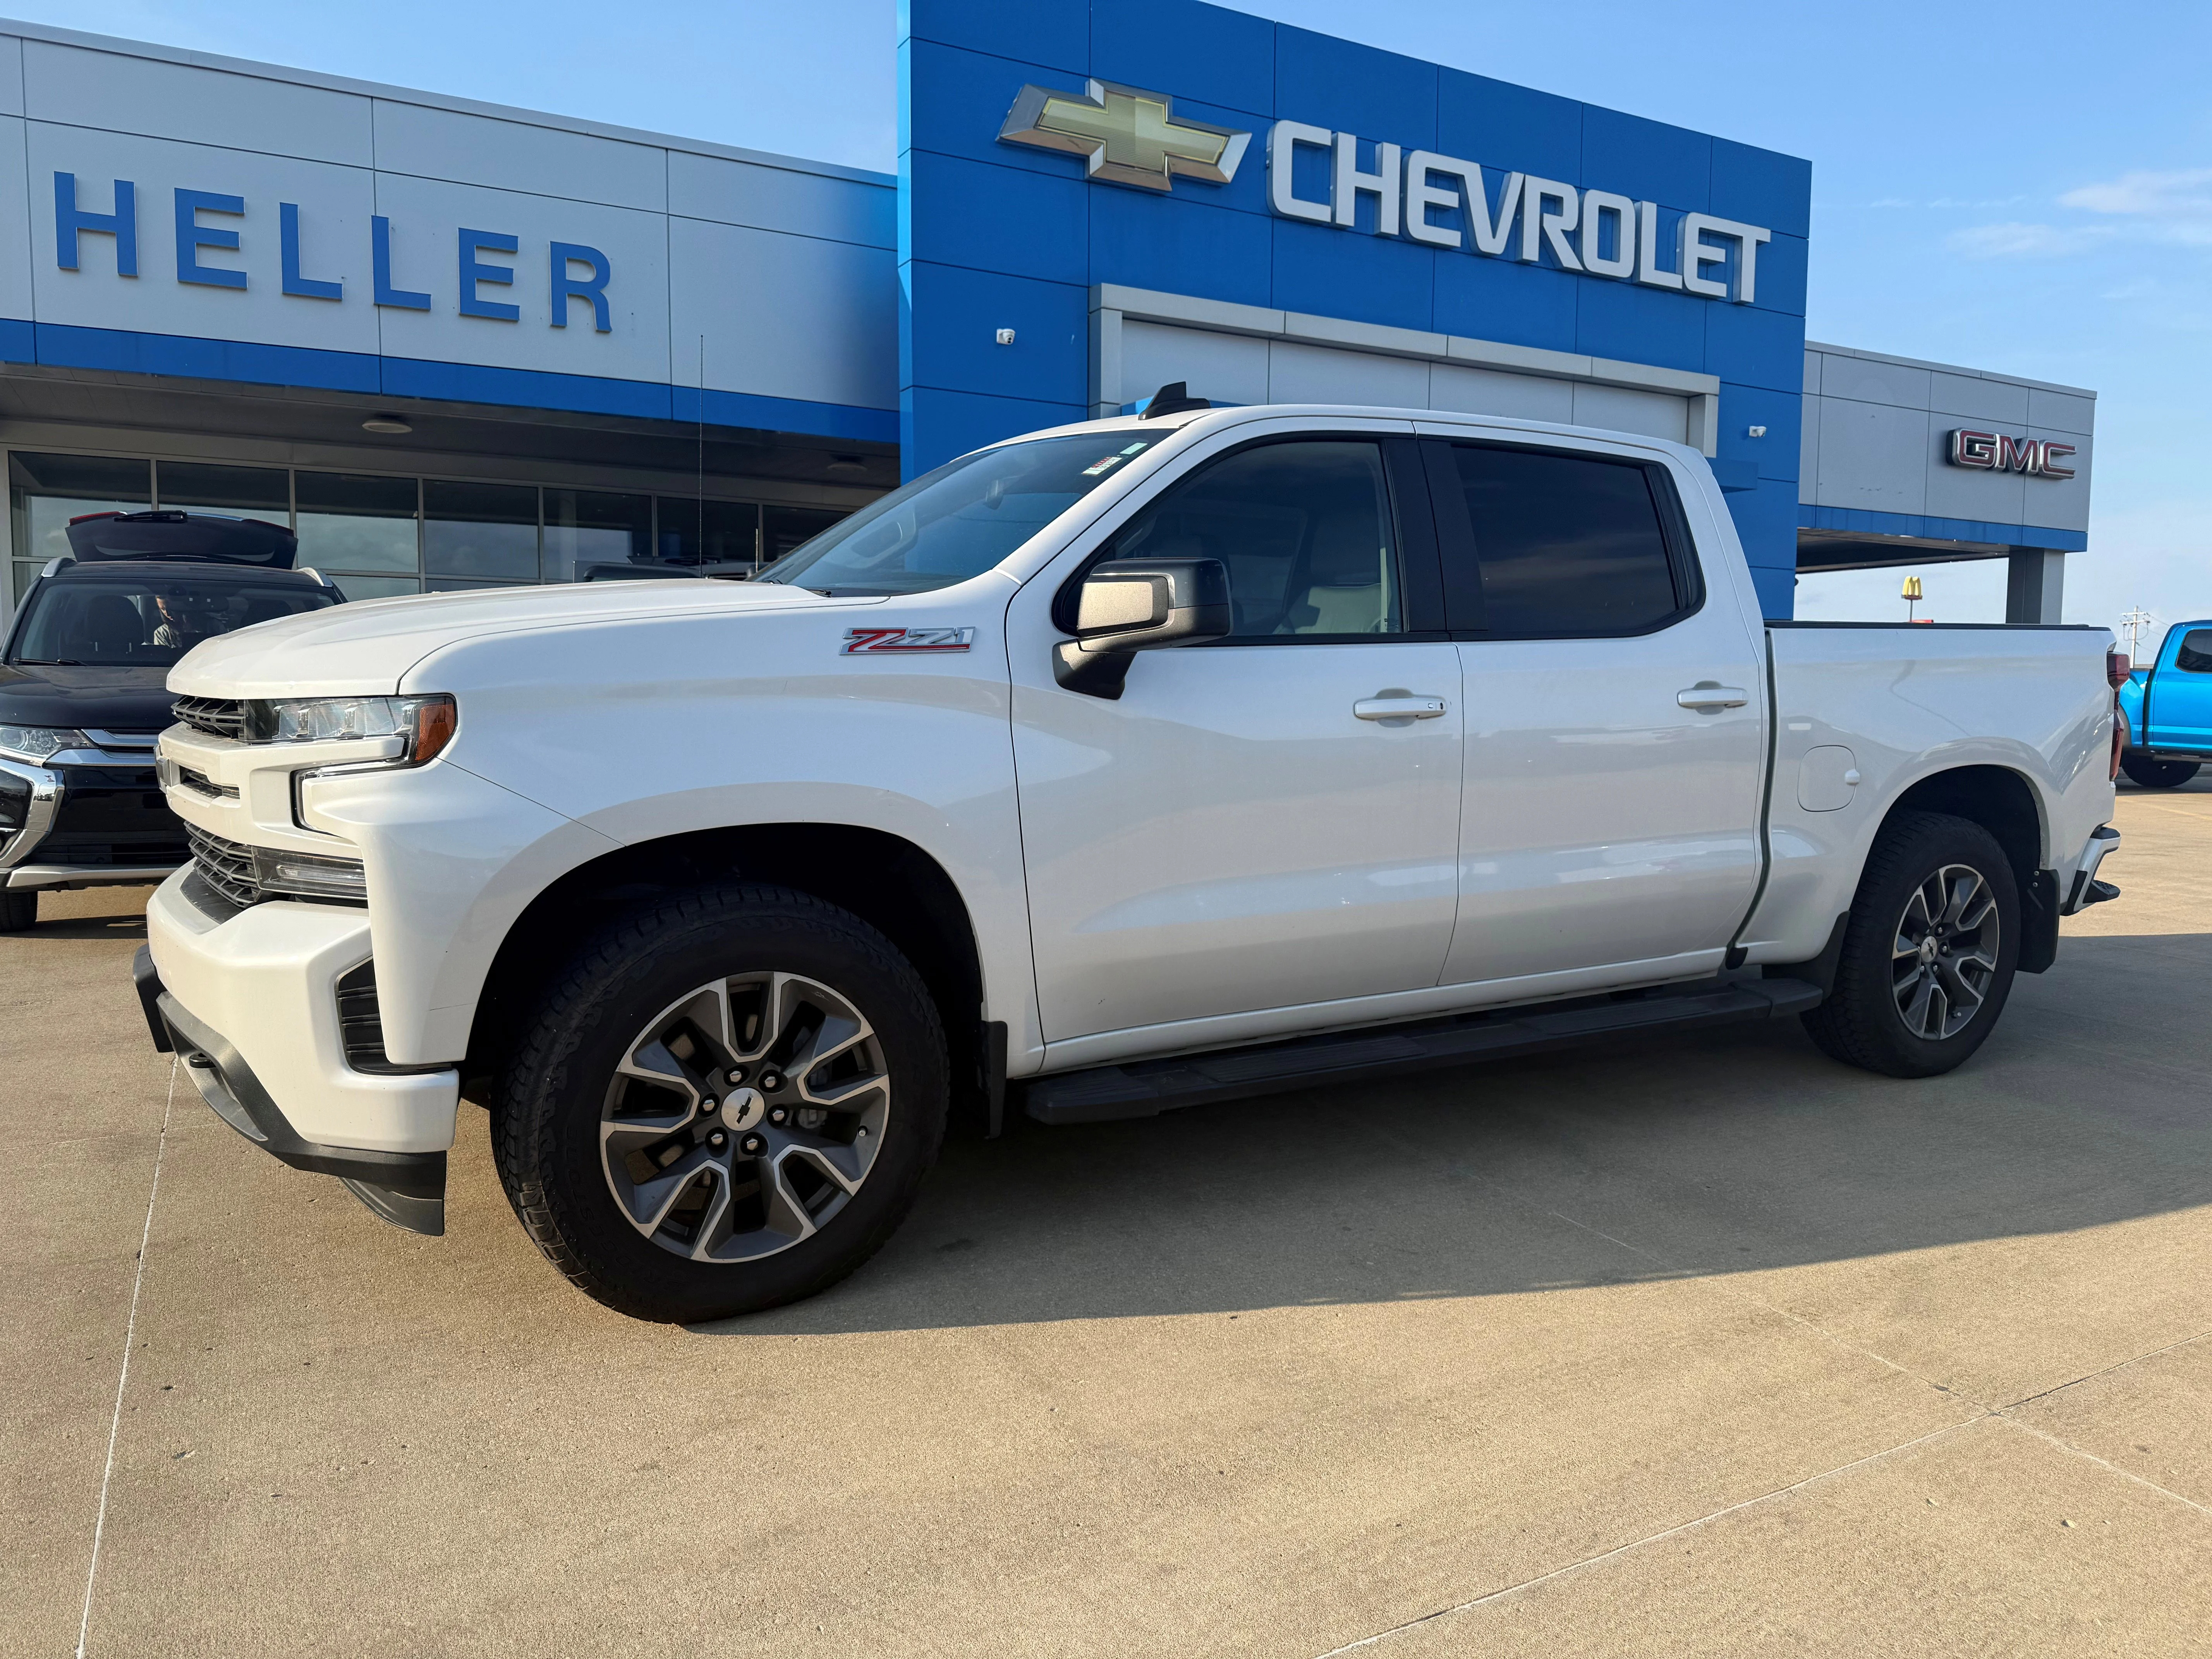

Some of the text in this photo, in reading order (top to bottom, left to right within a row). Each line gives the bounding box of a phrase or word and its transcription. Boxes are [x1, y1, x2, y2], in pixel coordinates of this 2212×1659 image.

[53, 170, 613, 333] HELLER
[1266, 119, 1771, 304] CHEVROLET
[1946, 428, 2076, 479] GMC
[839, 627, 976, 655] Z71
